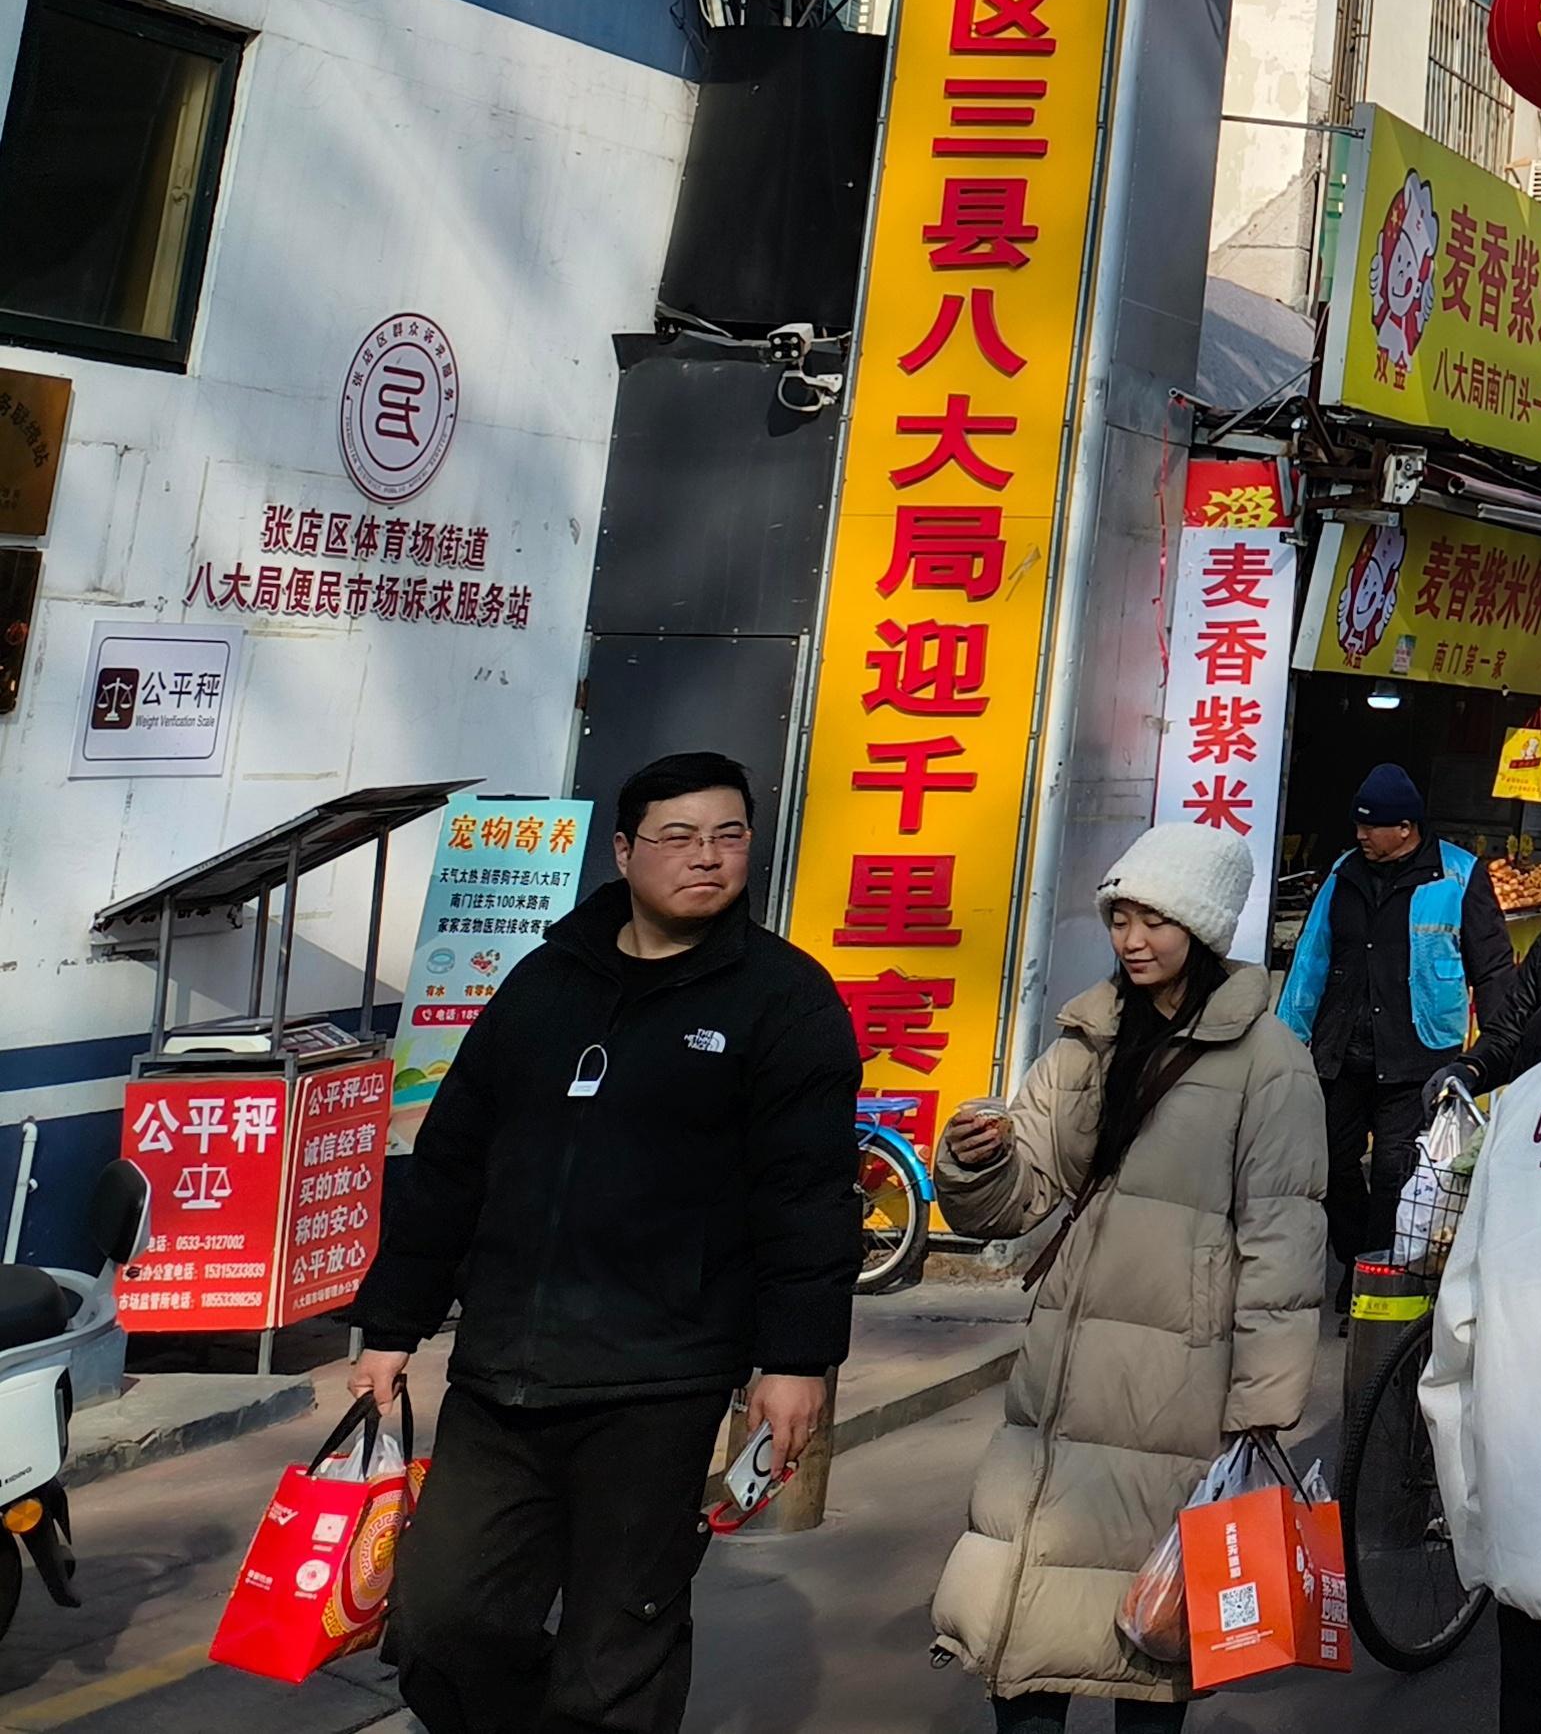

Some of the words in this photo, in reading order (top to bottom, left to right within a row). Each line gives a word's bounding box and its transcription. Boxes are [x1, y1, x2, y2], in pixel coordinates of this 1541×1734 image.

[262, 504, 488, 568] 张店区体育场街道
[185, 562, 532, 628] 八大局便民市场诉求服务站
[141, 671, 221, 709] 公平秤
[1183, 543, 1273, 837] 麦香紫米
[448, 813, 576, 855] 宠物寄养
[449, 892, 550, 912] 南门往东100米路南
[307, 1078, 361, 1116] 公平秤
[132, 1096, 278, 1155] 公平秤
[303, 1123, 376, 1168] 诚信经营
[298, 1162, 372, 1207] 买的放心
[294, 1201, 369, 1246] 称的安心
[292, 1239, 366, 1286] 公平放心
